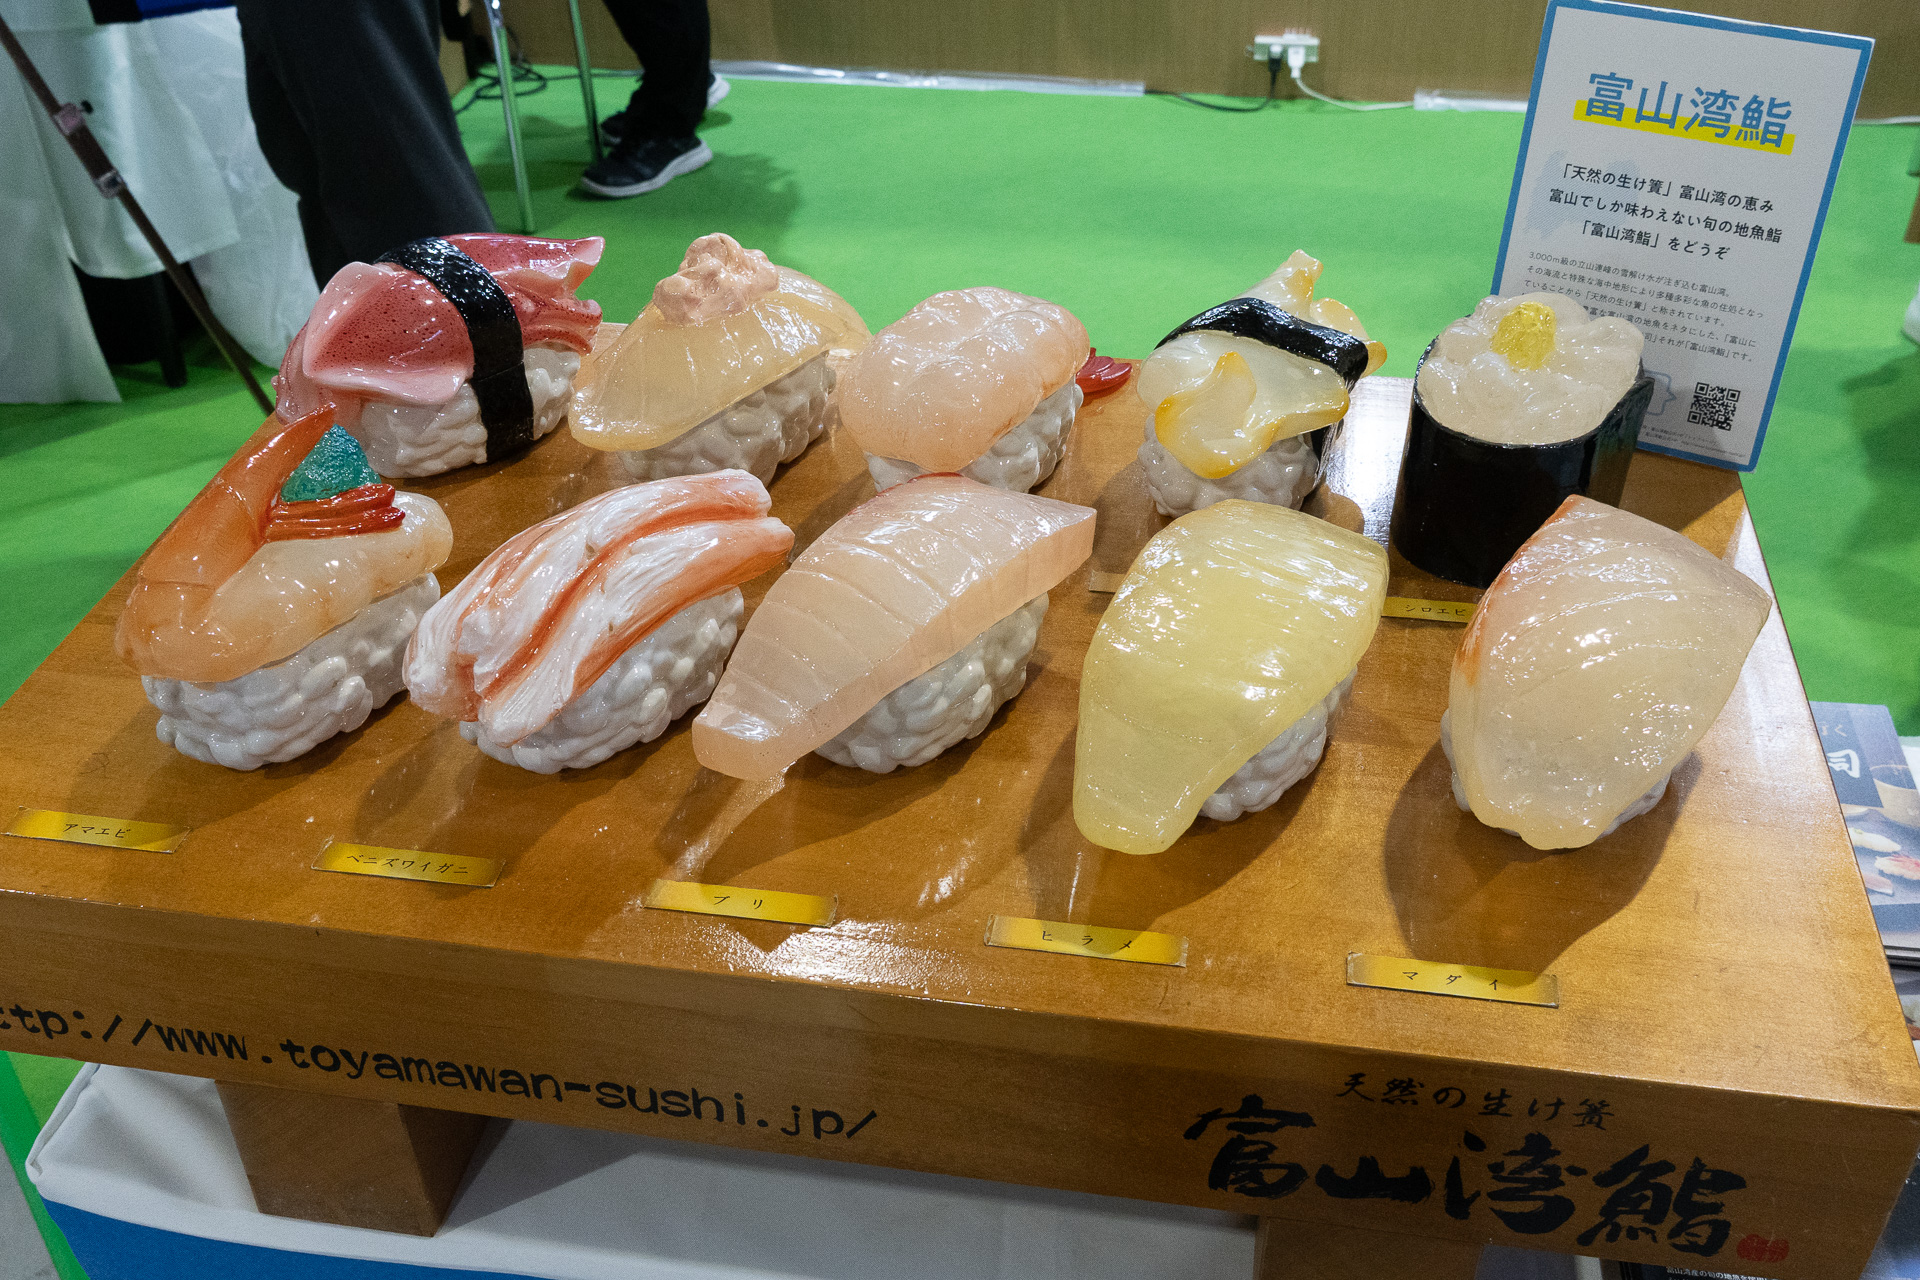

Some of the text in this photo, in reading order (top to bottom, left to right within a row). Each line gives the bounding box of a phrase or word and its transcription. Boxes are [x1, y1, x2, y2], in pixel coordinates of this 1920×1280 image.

[1585, 72, 1792, 148] 富山湾鮨
[1549, 188, 1783, 244] 富山でしか味わえない旬の地魚鮨
[1582, 220, 1731, 260] 「富山湾鮨」をどうぞ
[62, 823, 132, 839] アマエビ
[347, 854, 469, 875] ベニズワイガニ
[1040, 930, 1134, 951] ヒラメ
[1401, 970, 1501, 993] マダイ
[1183, 1094, 1748, 1258] 富山湾鮨
